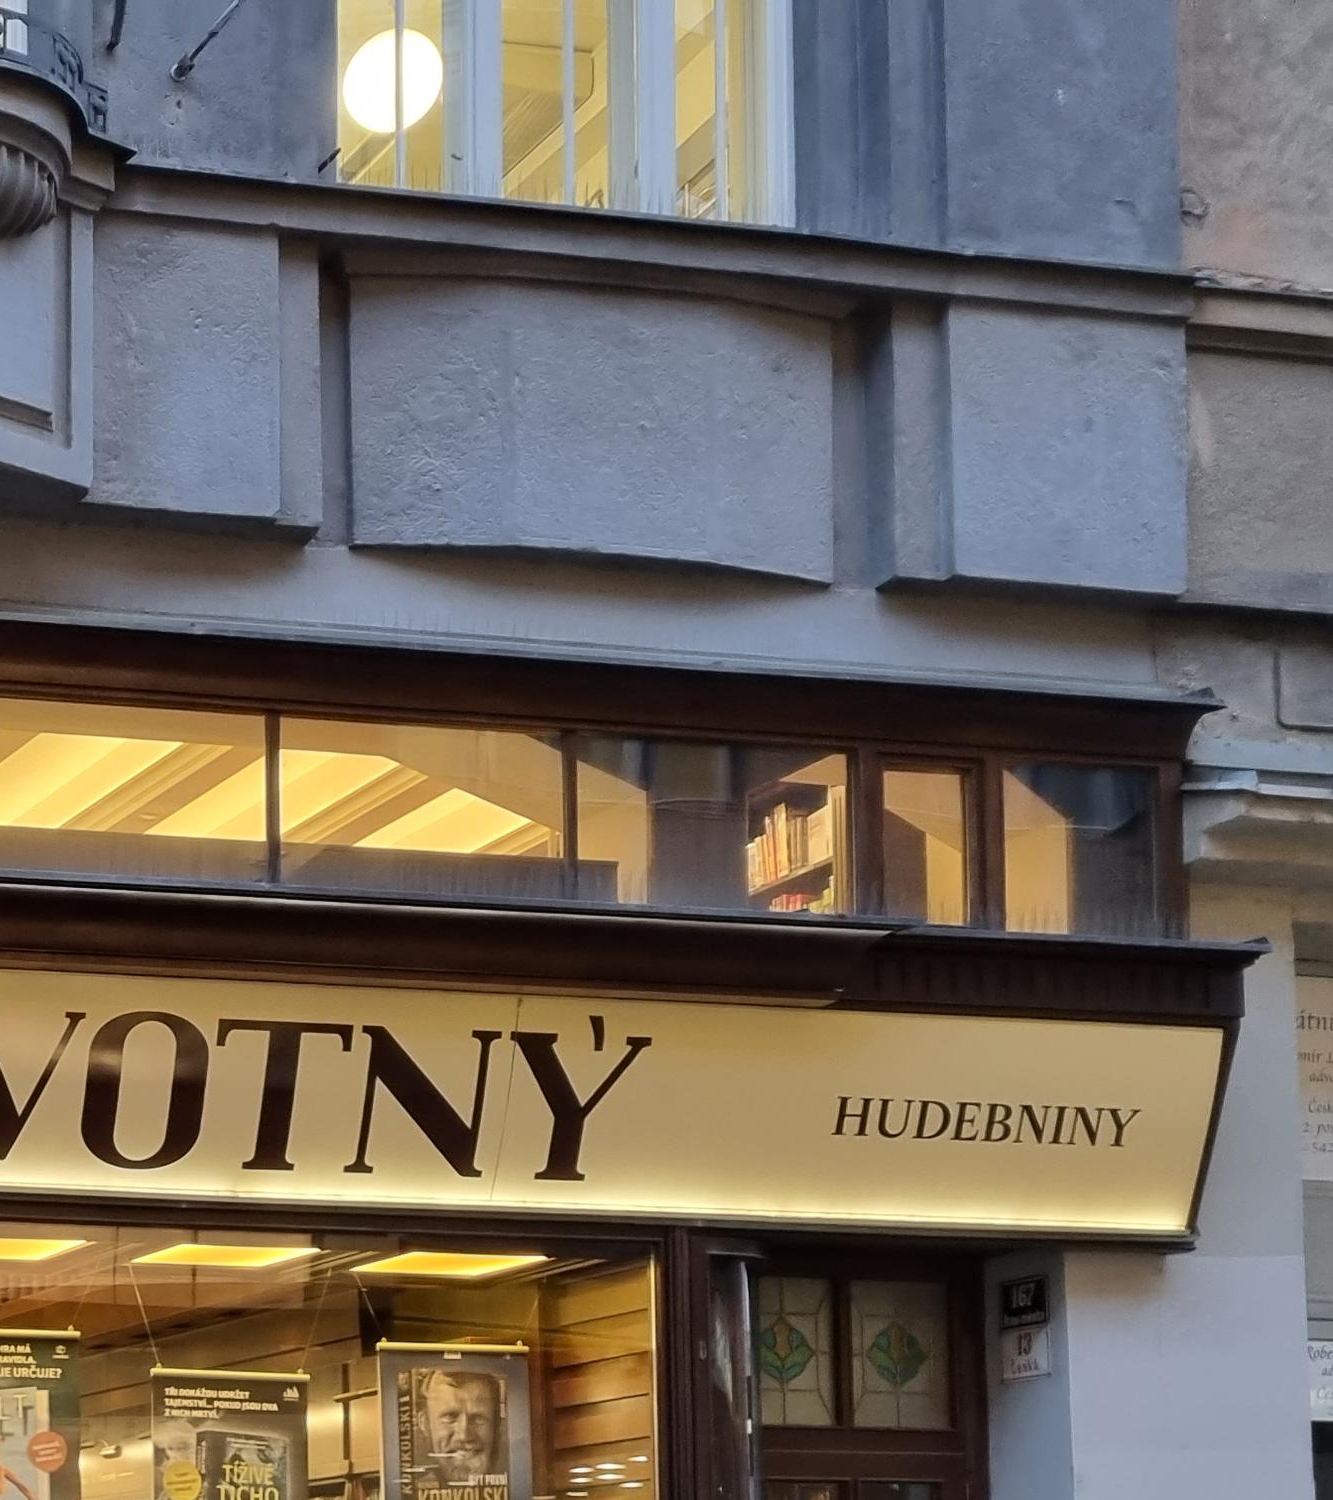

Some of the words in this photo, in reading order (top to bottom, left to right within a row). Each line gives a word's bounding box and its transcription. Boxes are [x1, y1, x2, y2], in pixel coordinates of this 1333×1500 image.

[831, 1096, 1143, 1147] HUDEBNINY
[17, 1343, 32, 1354] MÁ
[0, 1366, 13, 1379] JE
[14, 1365, 63, 1380] URČUJE?
